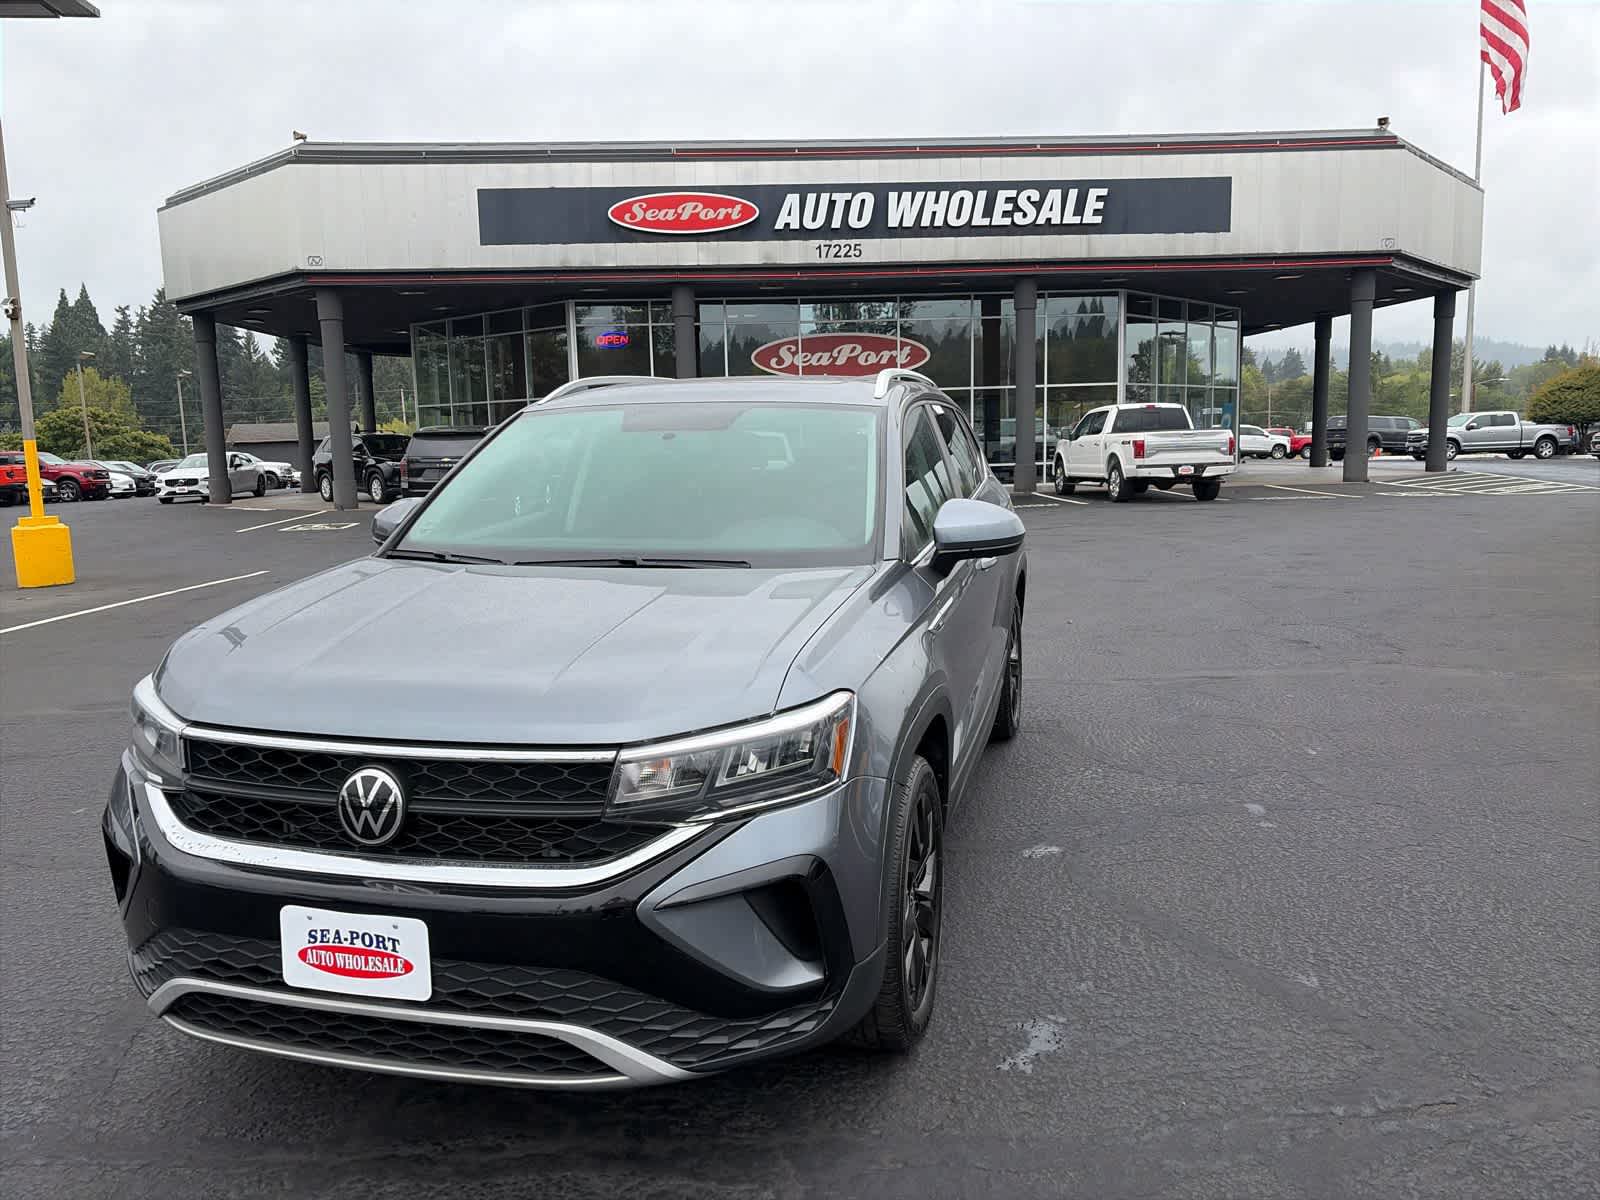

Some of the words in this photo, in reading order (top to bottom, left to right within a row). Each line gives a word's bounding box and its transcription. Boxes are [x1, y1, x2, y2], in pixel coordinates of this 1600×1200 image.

[774, 192, 875, 230] AUTO
[886, 188, 1108, 228] WHOLESALE
[815, 243, 862, 259] 17225
[595, 335, 629, 345] OPEN
[307, 928, 400, 953] SEA-PORT
[305, 949, 335, 968] AUTO
[335, 952, 406, 975] WHOLESALE
